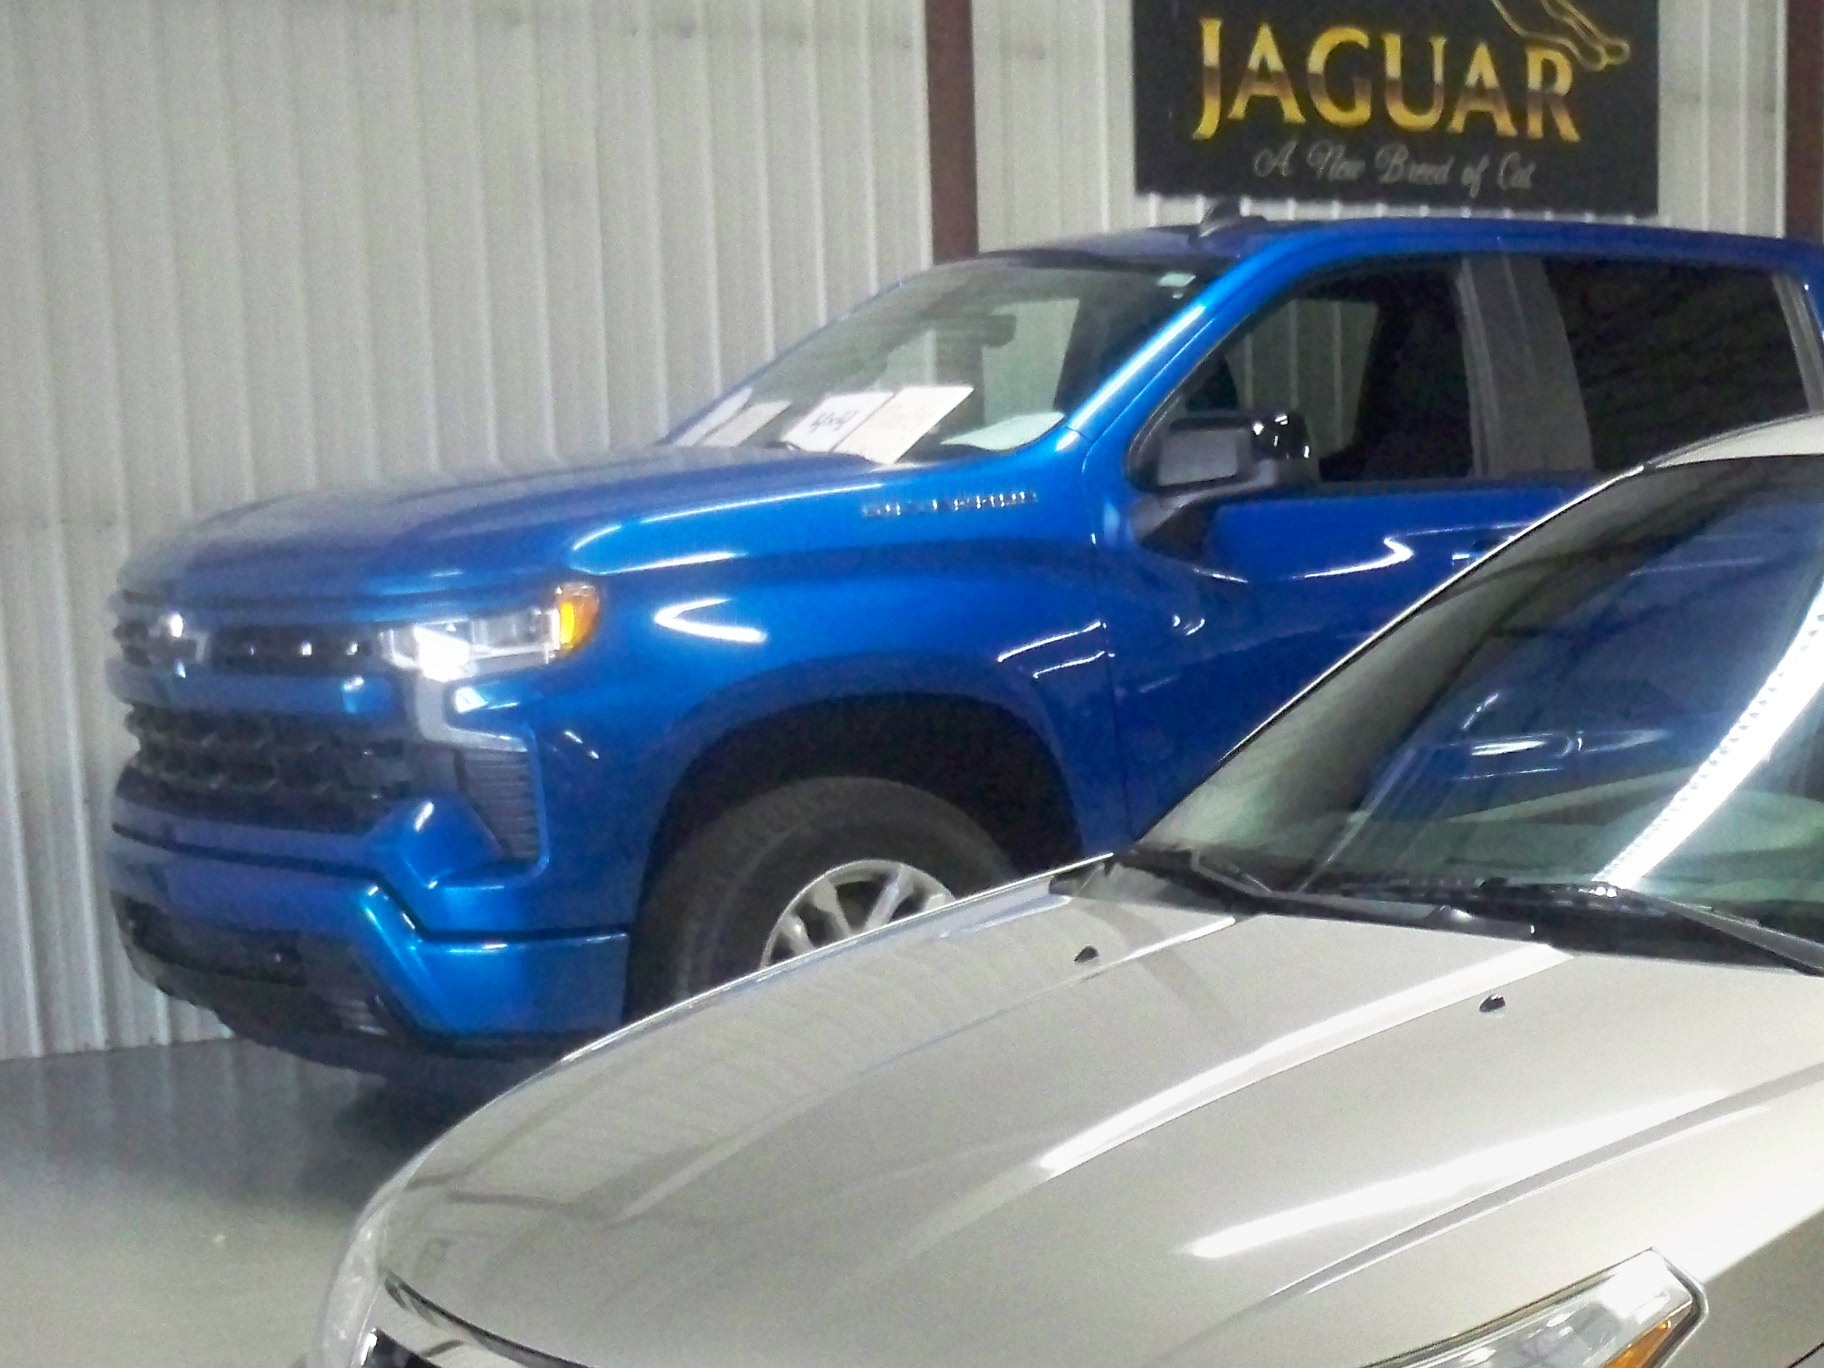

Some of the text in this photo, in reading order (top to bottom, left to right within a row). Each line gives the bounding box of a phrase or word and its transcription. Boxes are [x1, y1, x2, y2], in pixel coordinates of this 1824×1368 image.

[1193, 17, 1582, 142] JAGUAR
[1253, 140, 1297, 178] A
[1374, 142, 1455, 186] Breed
[1461, 154, 1490, 199] of
